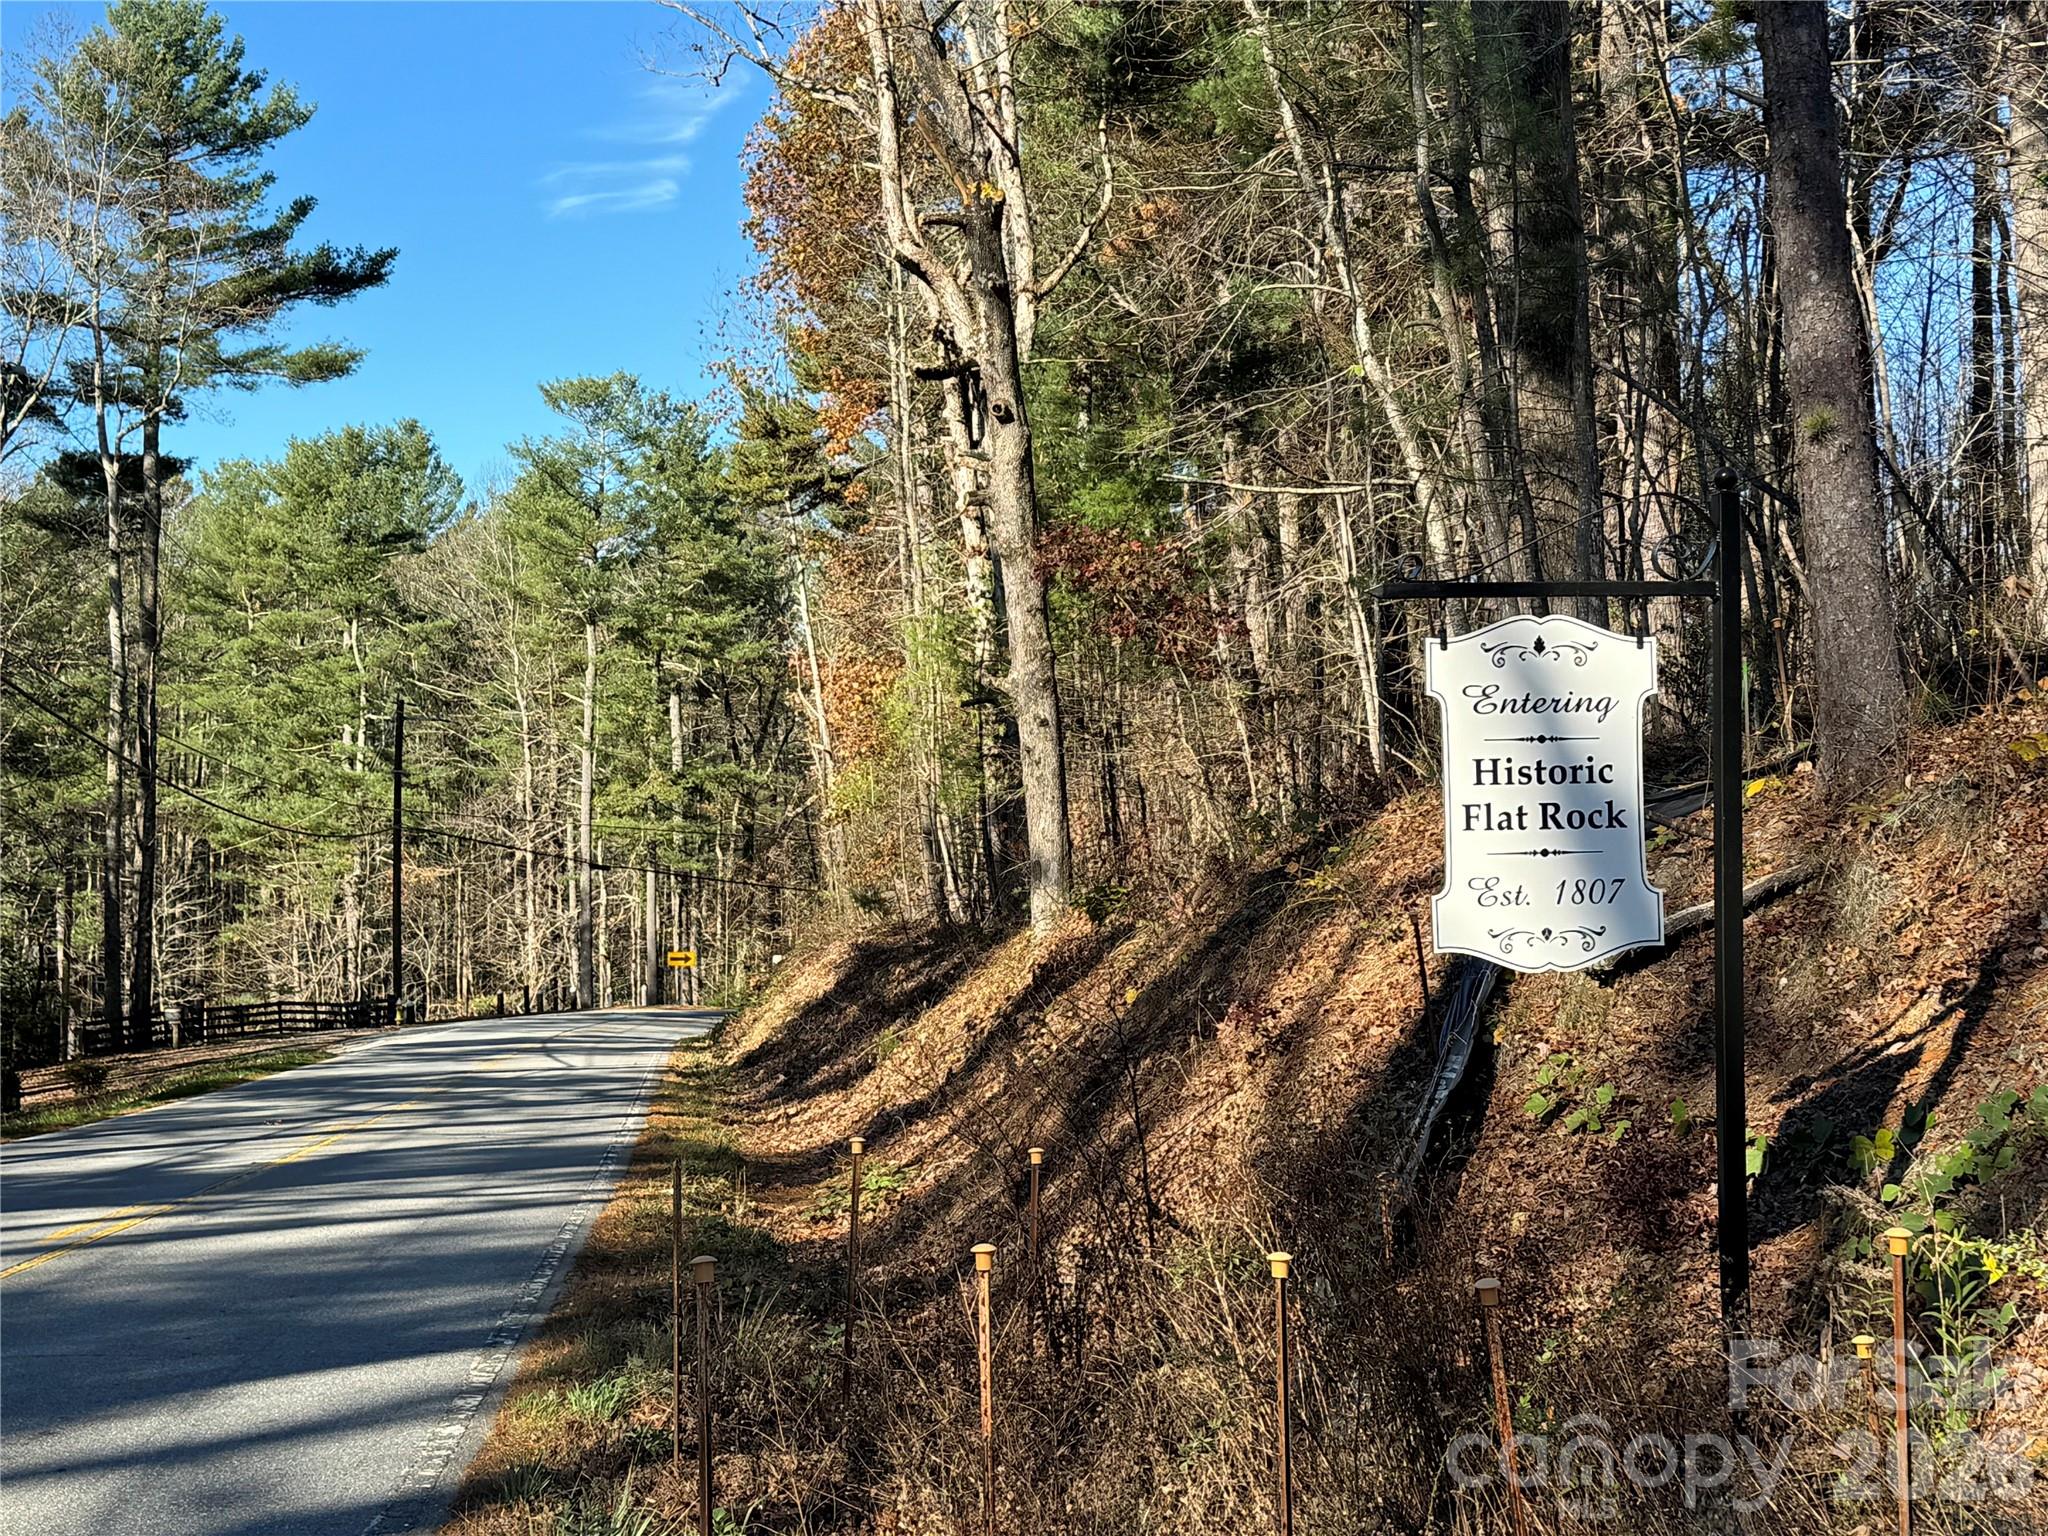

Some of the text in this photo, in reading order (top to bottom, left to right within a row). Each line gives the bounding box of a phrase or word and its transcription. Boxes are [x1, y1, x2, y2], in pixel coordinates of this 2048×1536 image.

[1462, 684, 1620, 723] Entering
[1473, 755, 1614, 786] Historic
[1462, 800, 1627, 832] Flat Rock
[1468, 877, 1626, 907] Est. 1807
